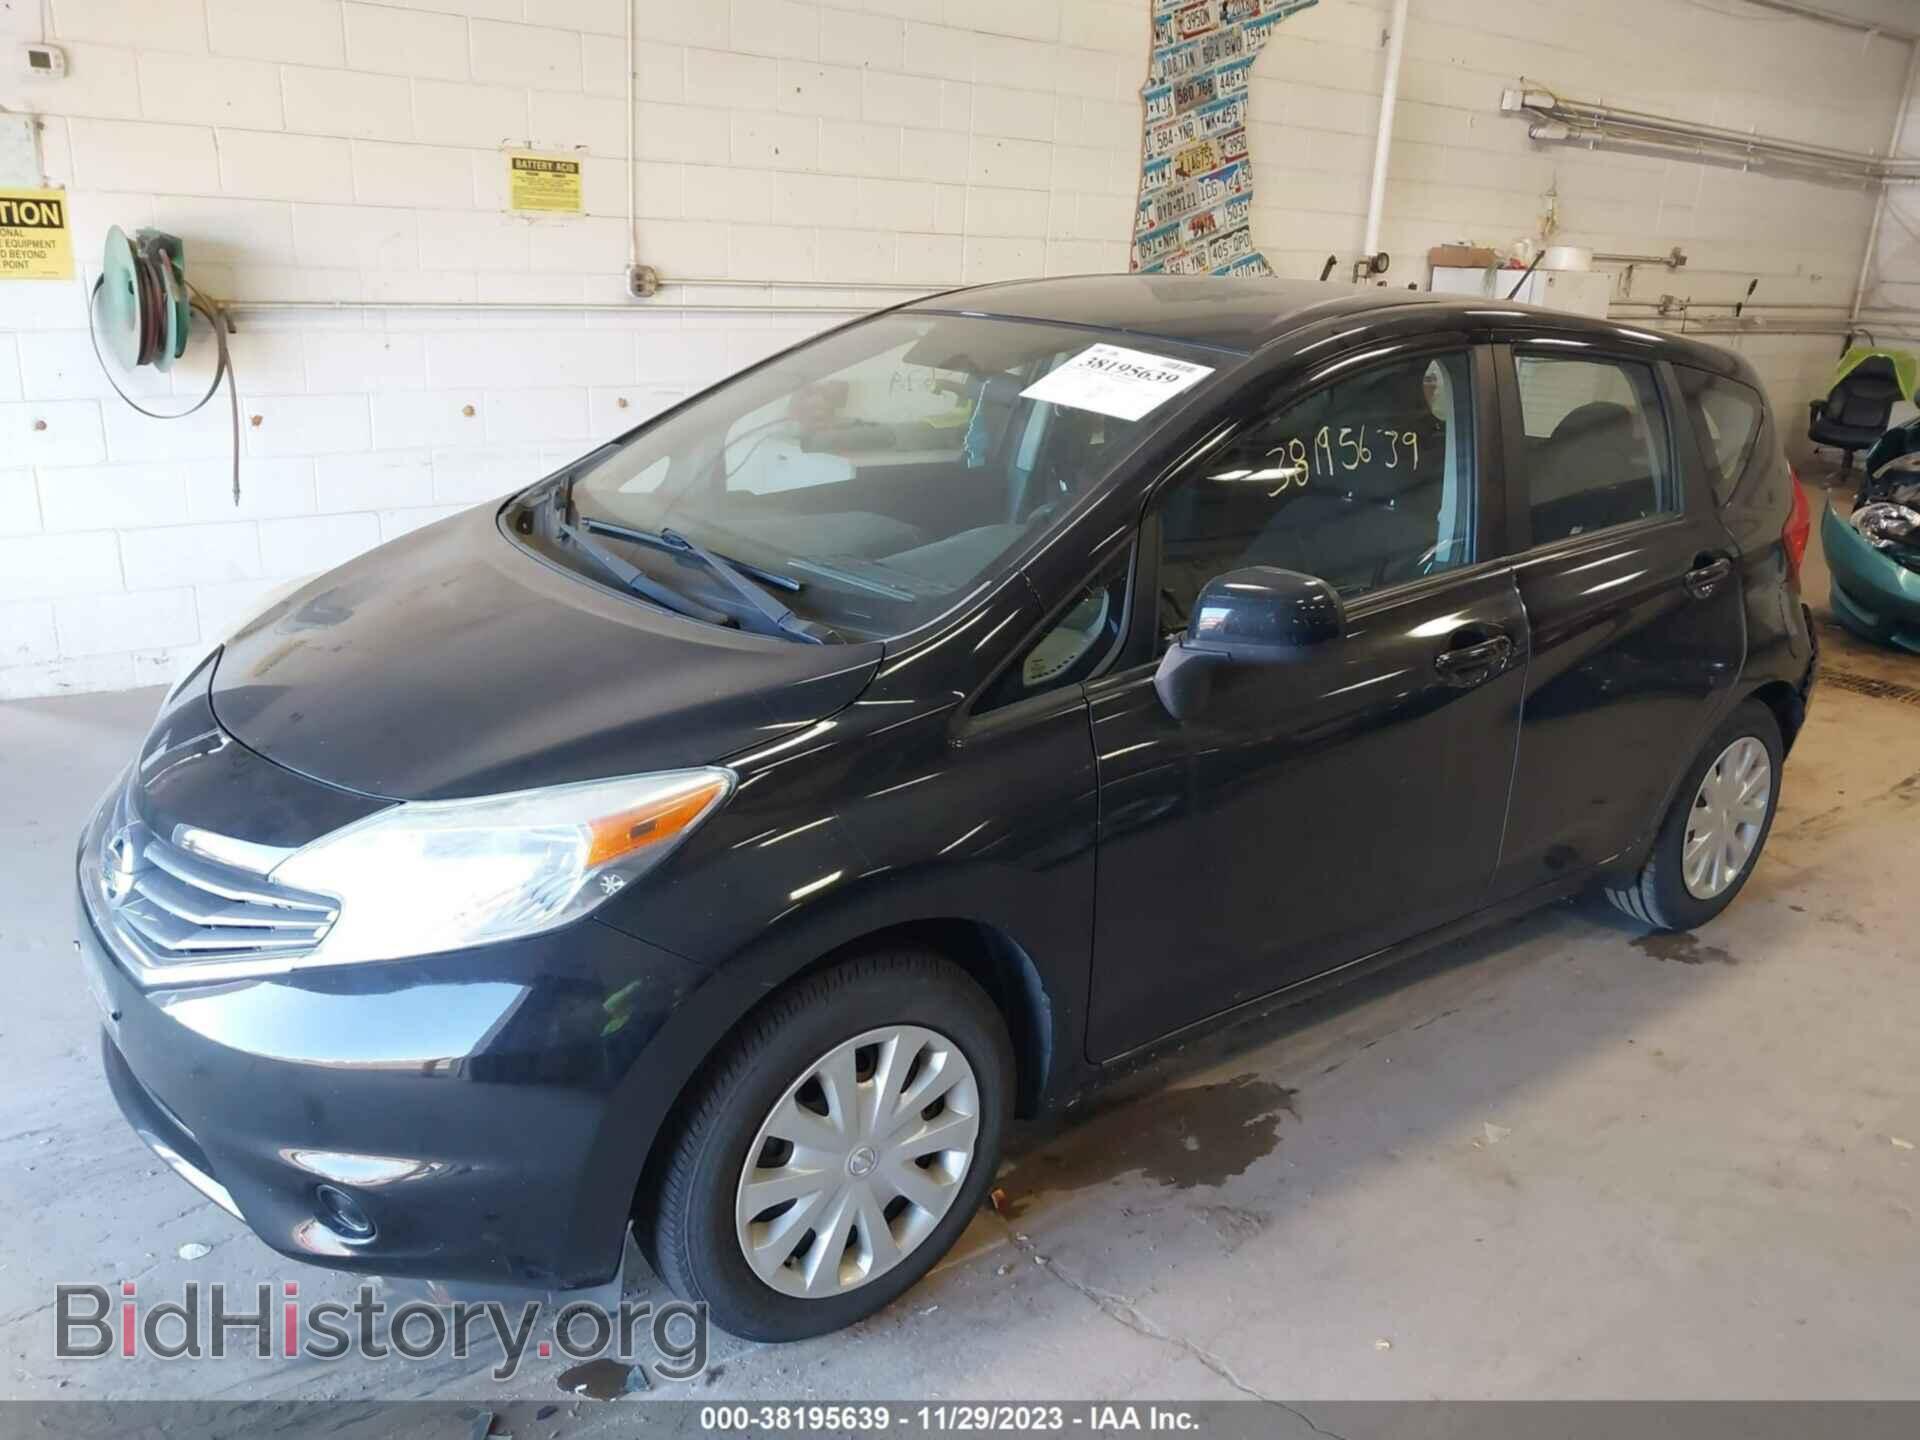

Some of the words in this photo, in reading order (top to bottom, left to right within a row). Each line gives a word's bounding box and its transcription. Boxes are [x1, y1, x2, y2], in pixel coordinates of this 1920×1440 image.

[515, 159, 552, 171] BATTERY
[555, 162, 576, 172] ACID
[5, 240, 56, 248] EQUIPMENT
[9, 250, 47, 259] BEYOND
[3, 260, 29, 269] POINT
[1079, 355, 1180, 384] 38195639
[1265, 424, 1419, 497] 38195639
